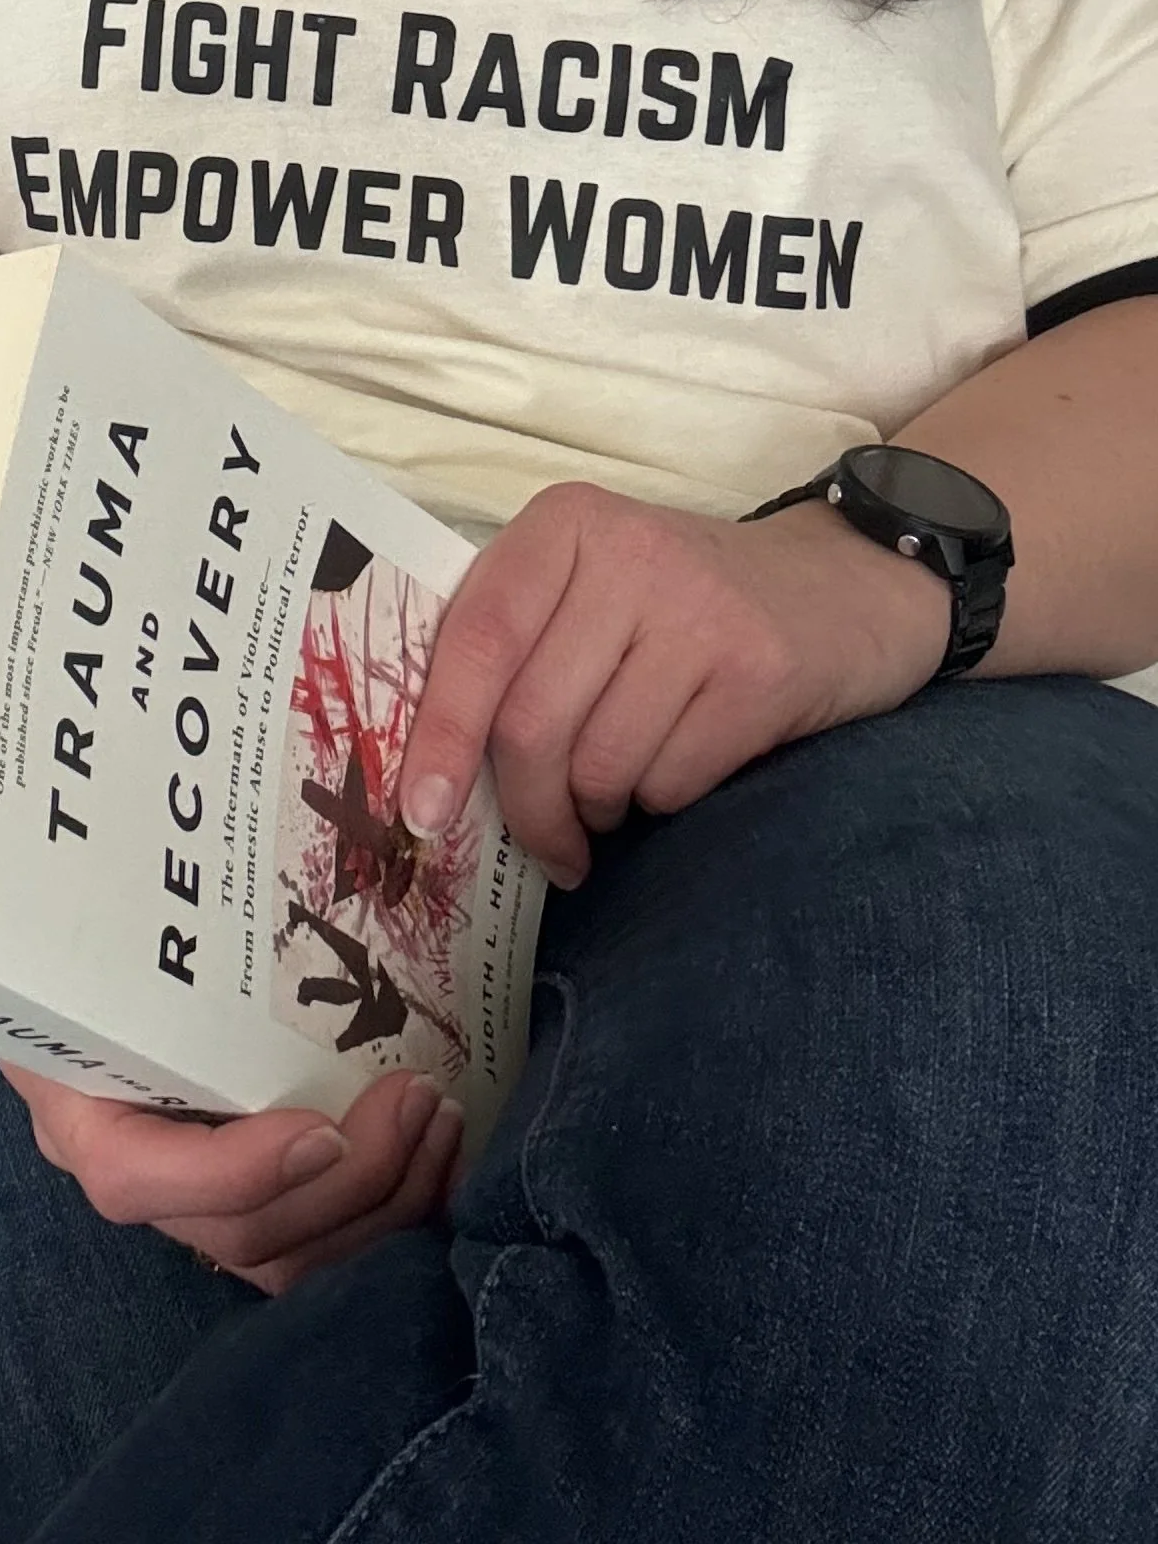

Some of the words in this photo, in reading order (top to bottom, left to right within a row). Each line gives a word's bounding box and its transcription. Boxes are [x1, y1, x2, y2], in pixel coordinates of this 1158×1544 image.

[390, 11, 793, 152] RACISM
[10, 135, 464, 269] EMPOWER
[509, 174, 863, 310] WOMEN
[55, 407, 65, 424] to
[58, 384, 70, 404] be
[44, 427, 60, 473] works
[26, 478, 49, 567] psychiatric
[284, 505, 309, 579] Terror
[7, 568, 31, 653] important
[15, 703, 29, 789] published
[23, 656, 35, 699] since
[51, 478, 68, 524] YORK
[62, 419, 80, 471] TIMES
[47, 421, 149, 844] TRAUMA
[263, 584, 292, 685] Political
[4, 656, 15, 699] most
[131, 610, 159, 714] AND
[237, 685, 249, 717] of
[260, 690, 272, 715] to
[0, 703, 11, 730] the
[158, 423, 261, 987] RECOVERY
[222, 724, 245, 855] Aftermath
[249, 721, 268, 797] Abuse
[221, 858, 234, 907] The
[242, 801, 260, 922] Domestic
[490, 823, 512, 910] HERM
[485, 923, 499, 949] L.
[509, 881, 524, 945] epilogue
[517, 862, 528, 879] by
[240, 930, 254, 999] From
[482, 960, 498, 1085] JUDITH
[106, 1072, 151, 1092] AND
